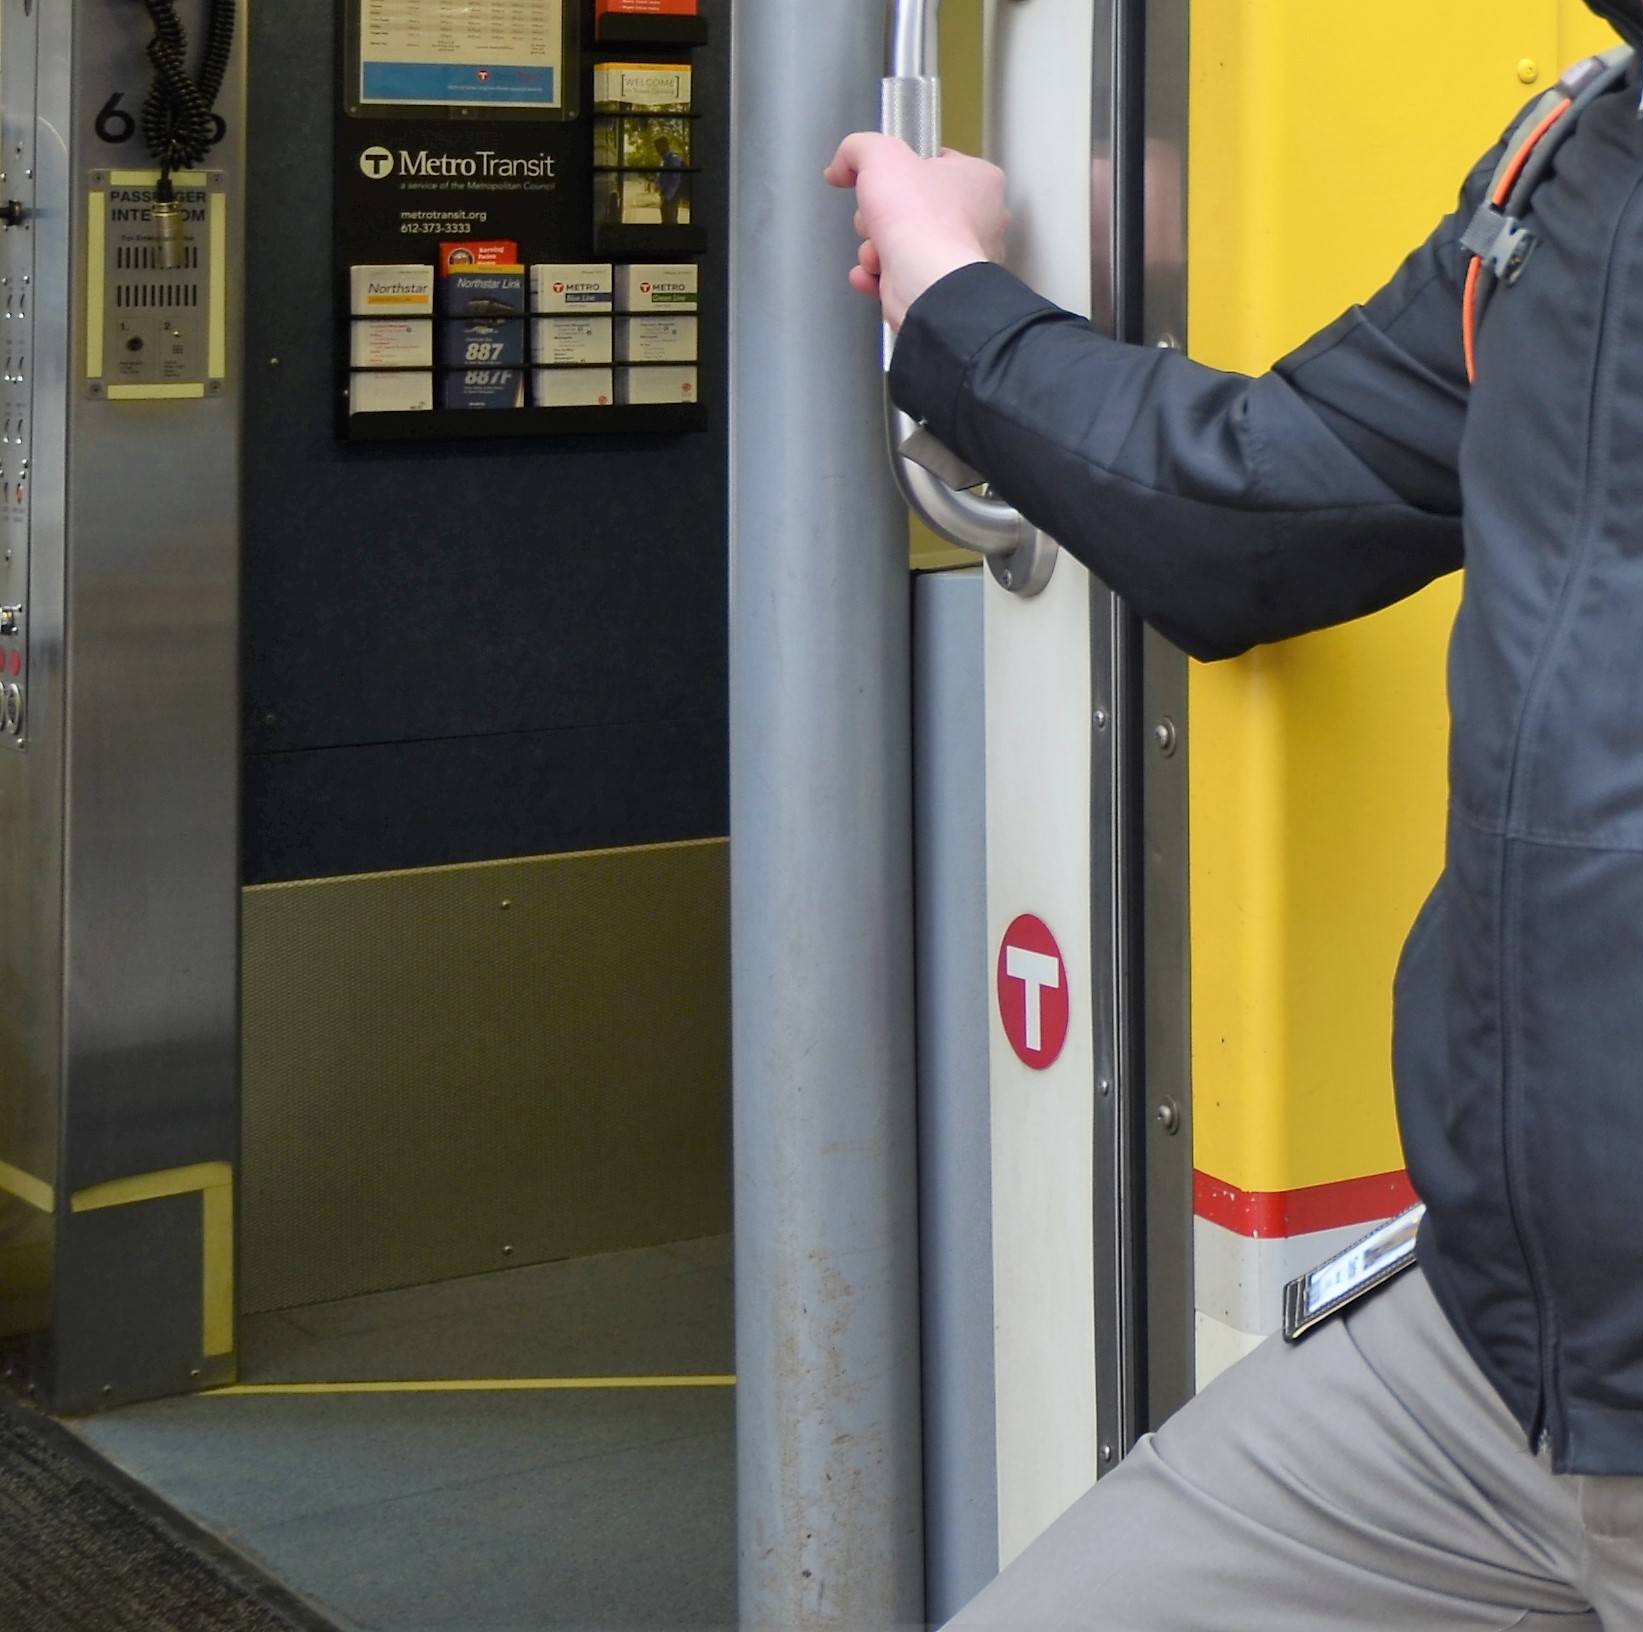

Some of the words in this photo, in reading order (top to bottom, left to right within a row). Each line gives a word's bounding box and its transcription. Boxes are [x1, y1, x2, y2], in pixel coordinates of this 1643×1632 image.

[110, 191, 206, 202] PASSGER
[400, 209, 488, 222] metrotransit.org
[400, 223, 472, 234] 612-373-3333
[368, 282, 428, 295] Northstar
[457, 277, 501, 289] Northstar
[503, 279, 521, 289] Link
[566, 283, 600, 292] METRO
[652, 283, 686, 292] METRO
[465, 342, 504, 361] 887
